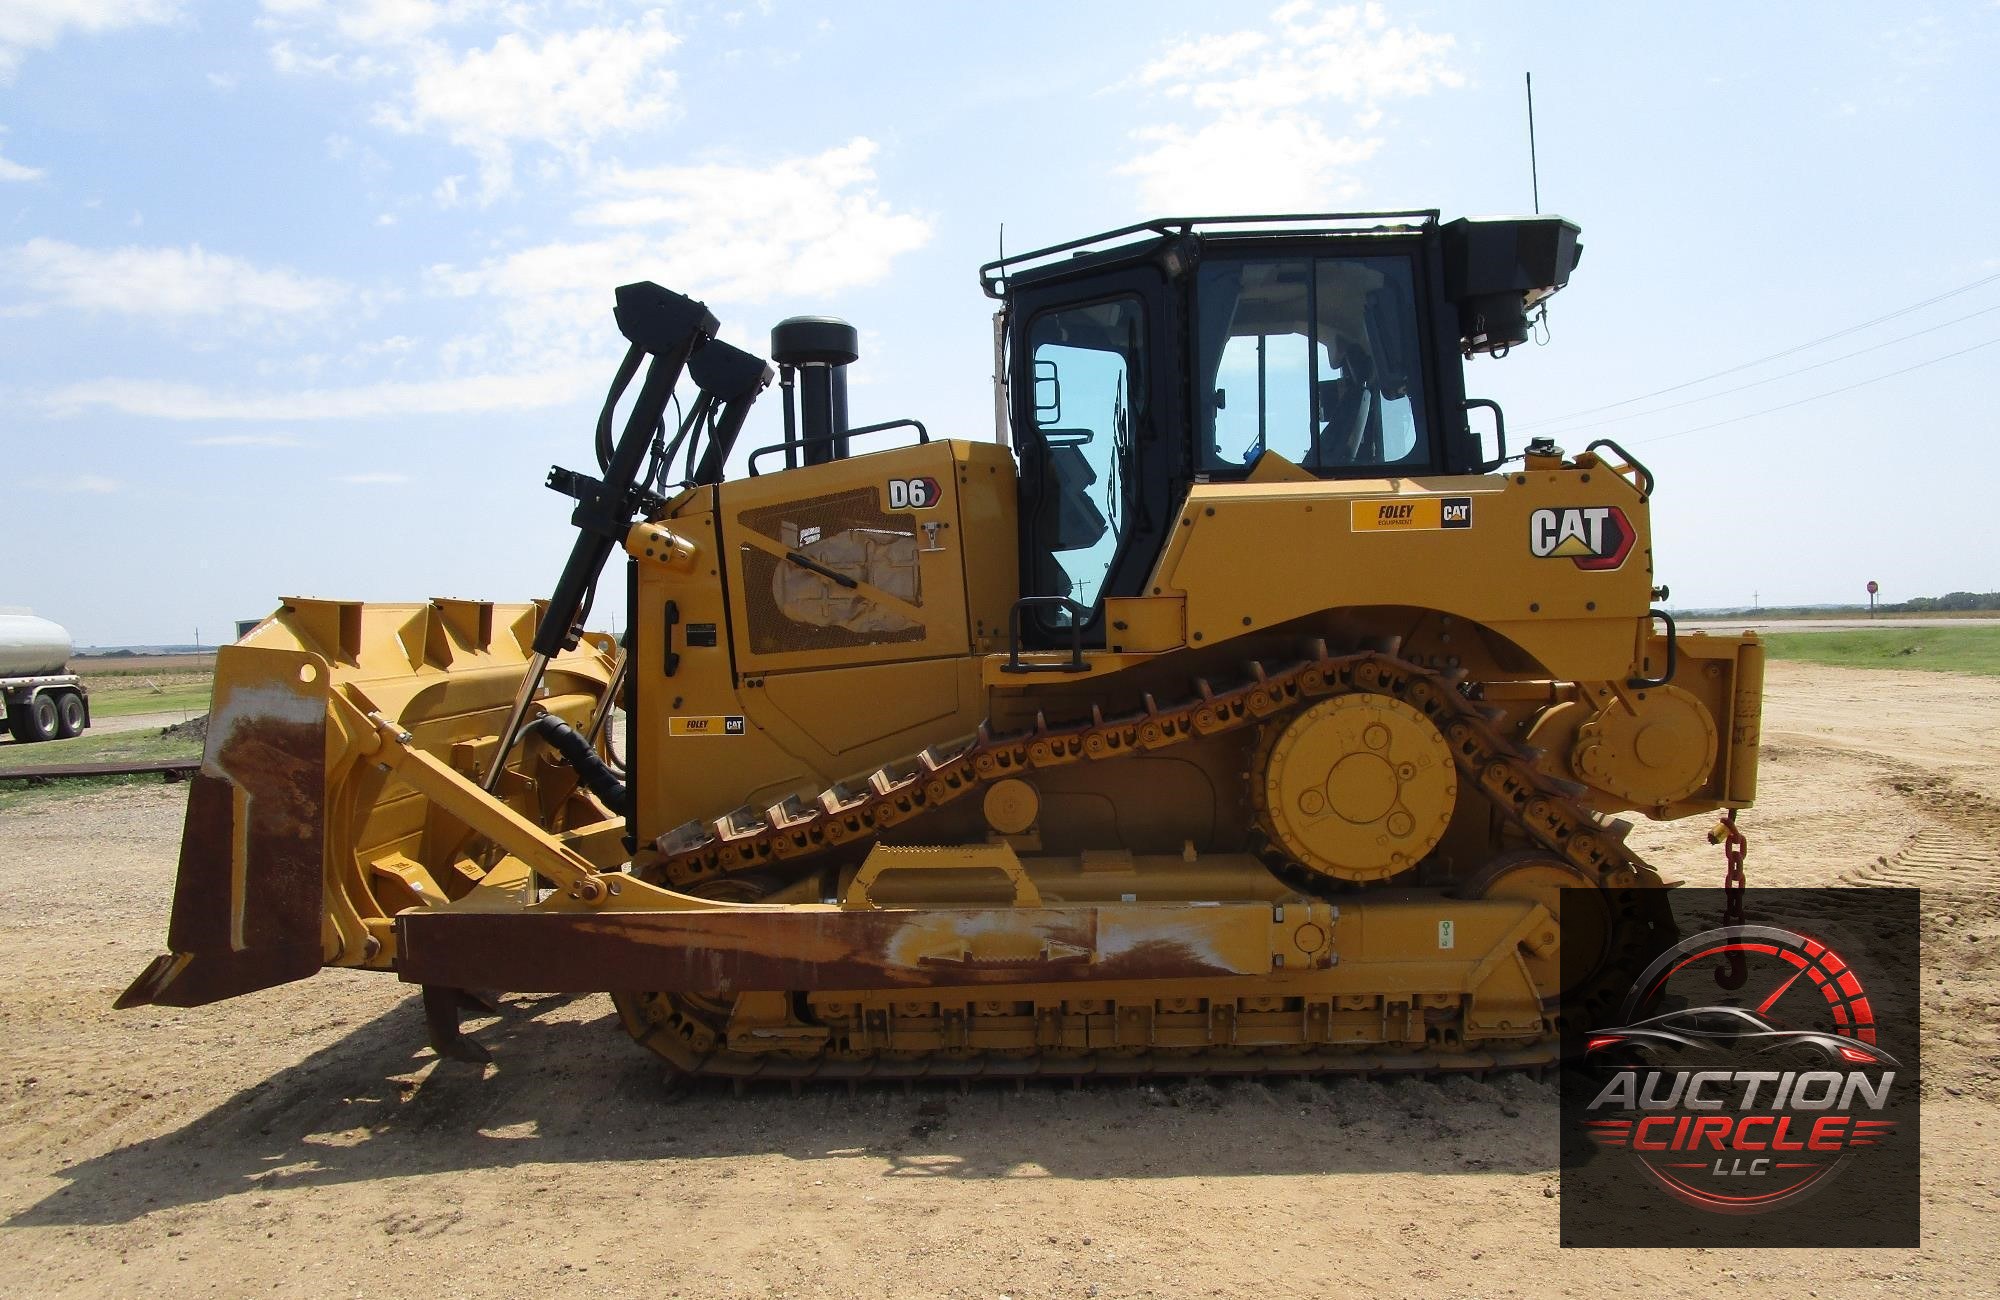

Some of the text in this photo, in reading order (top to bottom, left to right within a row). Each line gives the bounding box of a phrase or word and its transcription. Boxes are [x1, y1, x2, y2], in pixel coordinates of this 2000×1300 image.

[890, 480, 926, 507] D6
[1378, 505, 1415, 518] FOLEY
[1443, 505, 1468, 520] CAT
[1531, 508, 1609, 556] CAT
[687, 720, 708, 728] FOLEY
[726, 721, 742, 730] CAT
